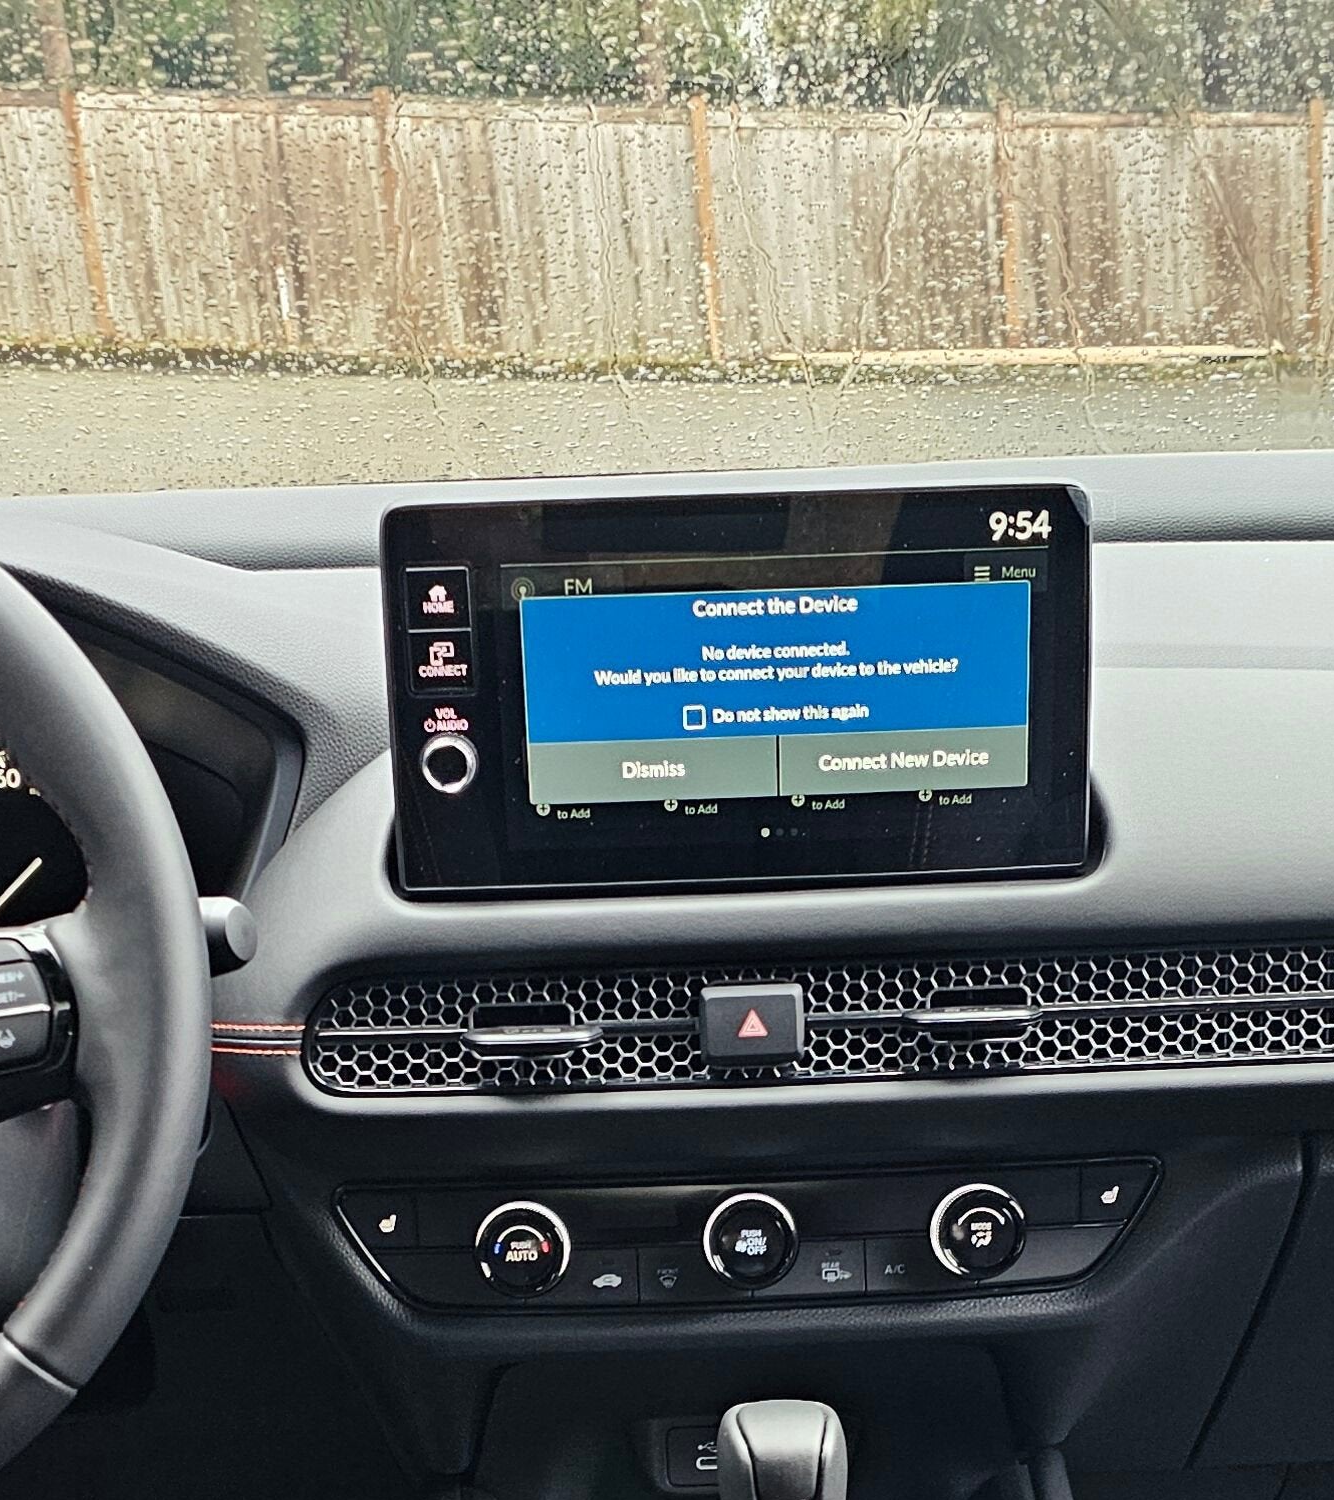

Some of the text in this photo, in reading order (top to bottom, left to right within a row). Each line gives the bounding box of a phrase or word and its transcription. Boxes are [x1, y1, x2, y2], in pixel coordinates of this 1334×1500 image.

[988, 509, 1052, 541] 9:54
[1001, 566, 1036, 578] Menu
[564, 578, 593, 595] FM
[422, 600, 455, 614] HOME
[692, 595, 859, 617] Connect the Device
[702, 641, 851, 661] No device connected.
[418, 664, 468, 678] CONNECT
[594, 658, 959, 687] Would you like to connect your device to the vehicle?
[434, 707, 458, 720] VOL
[712, 703, 870, 723] Do not show this again
[436, 719, 468, 732] AUDIO
[818, 748, 989, 772] Connect New Device
[621, 760, 686, 779] Dismiss
[812, 799, 845, 811] to Add
[938, 794, 972, 806] to Add
[557, 808, 591, 820] to Add
[684, 804, 718, 815] to Add
[741, 1229, 762, 1238] PUSH
[505, 1250, 538, 1262] AUTO
[746, 1244, 767, 1256] OFF
[884, 1264, 906, 1275] A/C
